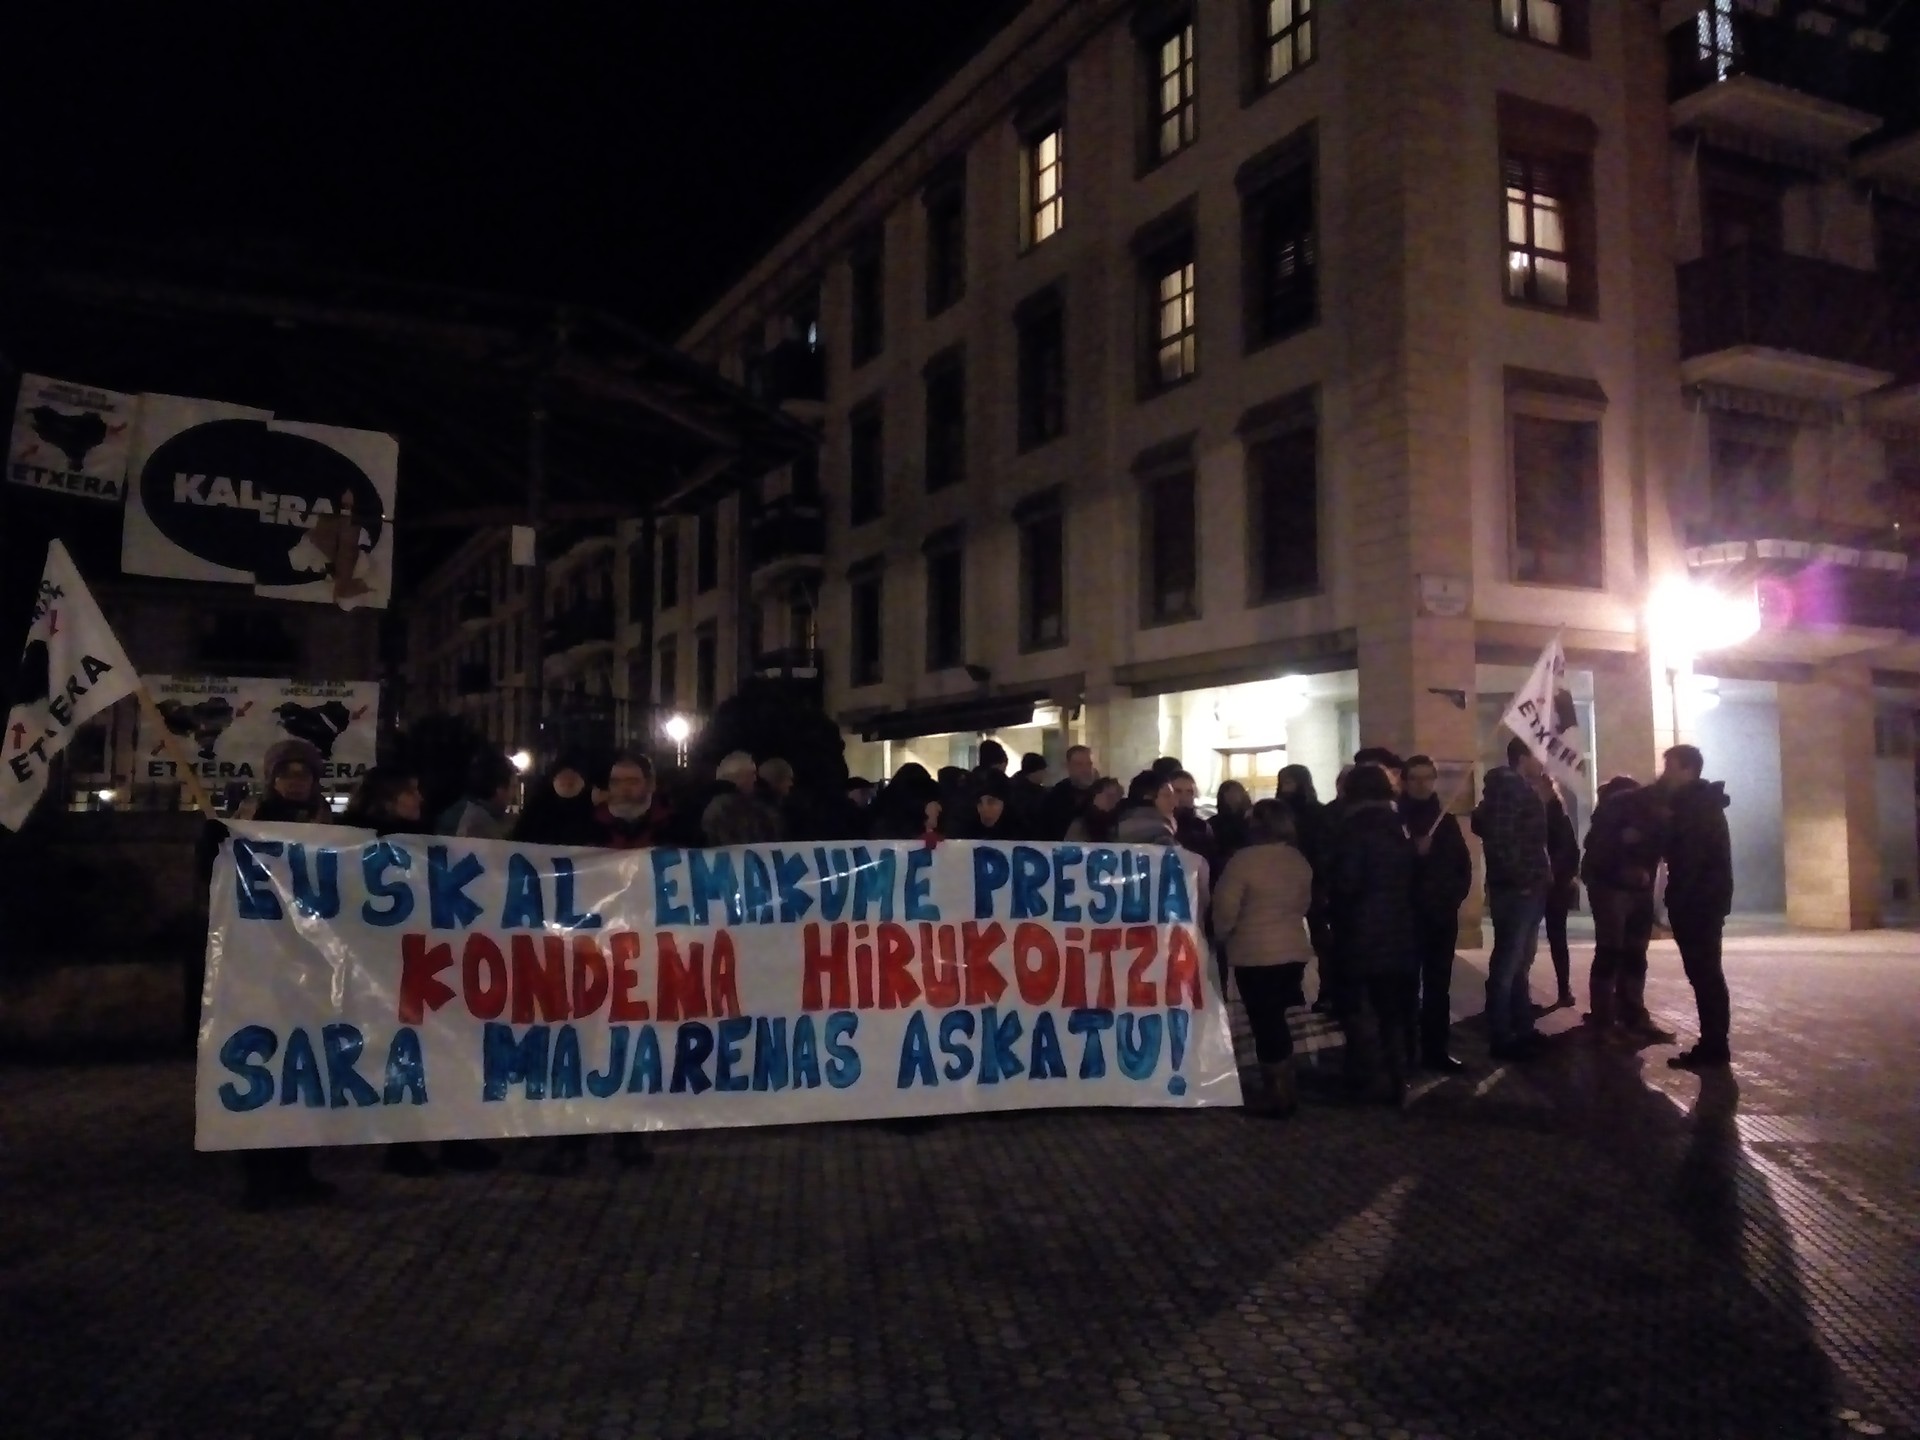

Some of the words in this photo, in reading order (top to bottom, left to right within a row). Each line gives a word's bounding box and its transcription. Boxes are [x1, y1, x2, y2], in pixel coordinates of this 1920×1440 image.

[13, 463, 118, 497] ETXERA
[232, 837, 603, 930] EUSKAL
[651, 845, 941, 927] EMAKUME
[398, 931, 742, 1024] KONDENA
[218, 1022, 429, 1113] SARA
[482, 1010, 859, 1103] MAJARENAS
[897, 1006, 1190, 1096] ASKATU!
